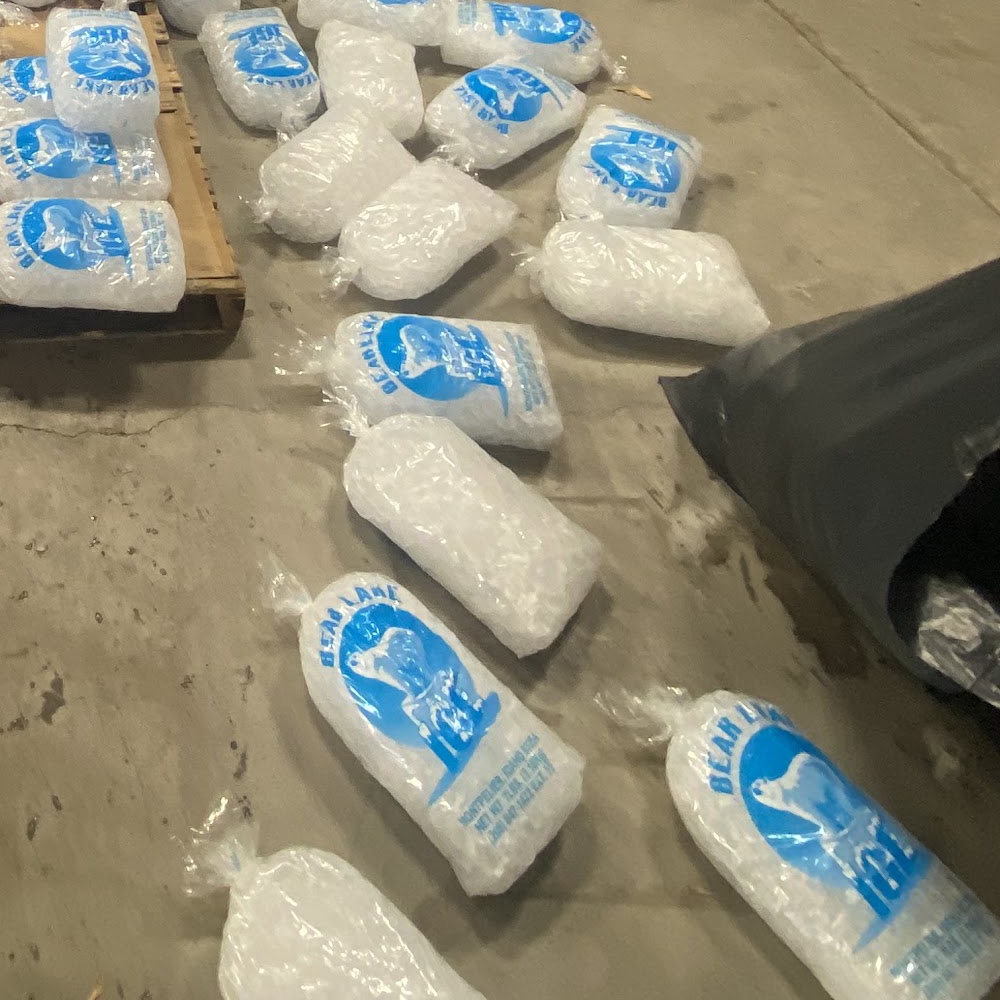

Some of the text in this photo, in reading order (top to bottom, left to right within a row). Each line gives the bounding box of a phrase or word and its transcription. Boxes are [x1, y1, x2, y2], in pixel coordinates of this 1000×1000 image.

[6, 230, 36, 270] BEAR
[361, 348, 398, 395] BEAR
[319, 584, 400, 668] BEAR LAKE
[708, 716, 743, 796] BEAR
